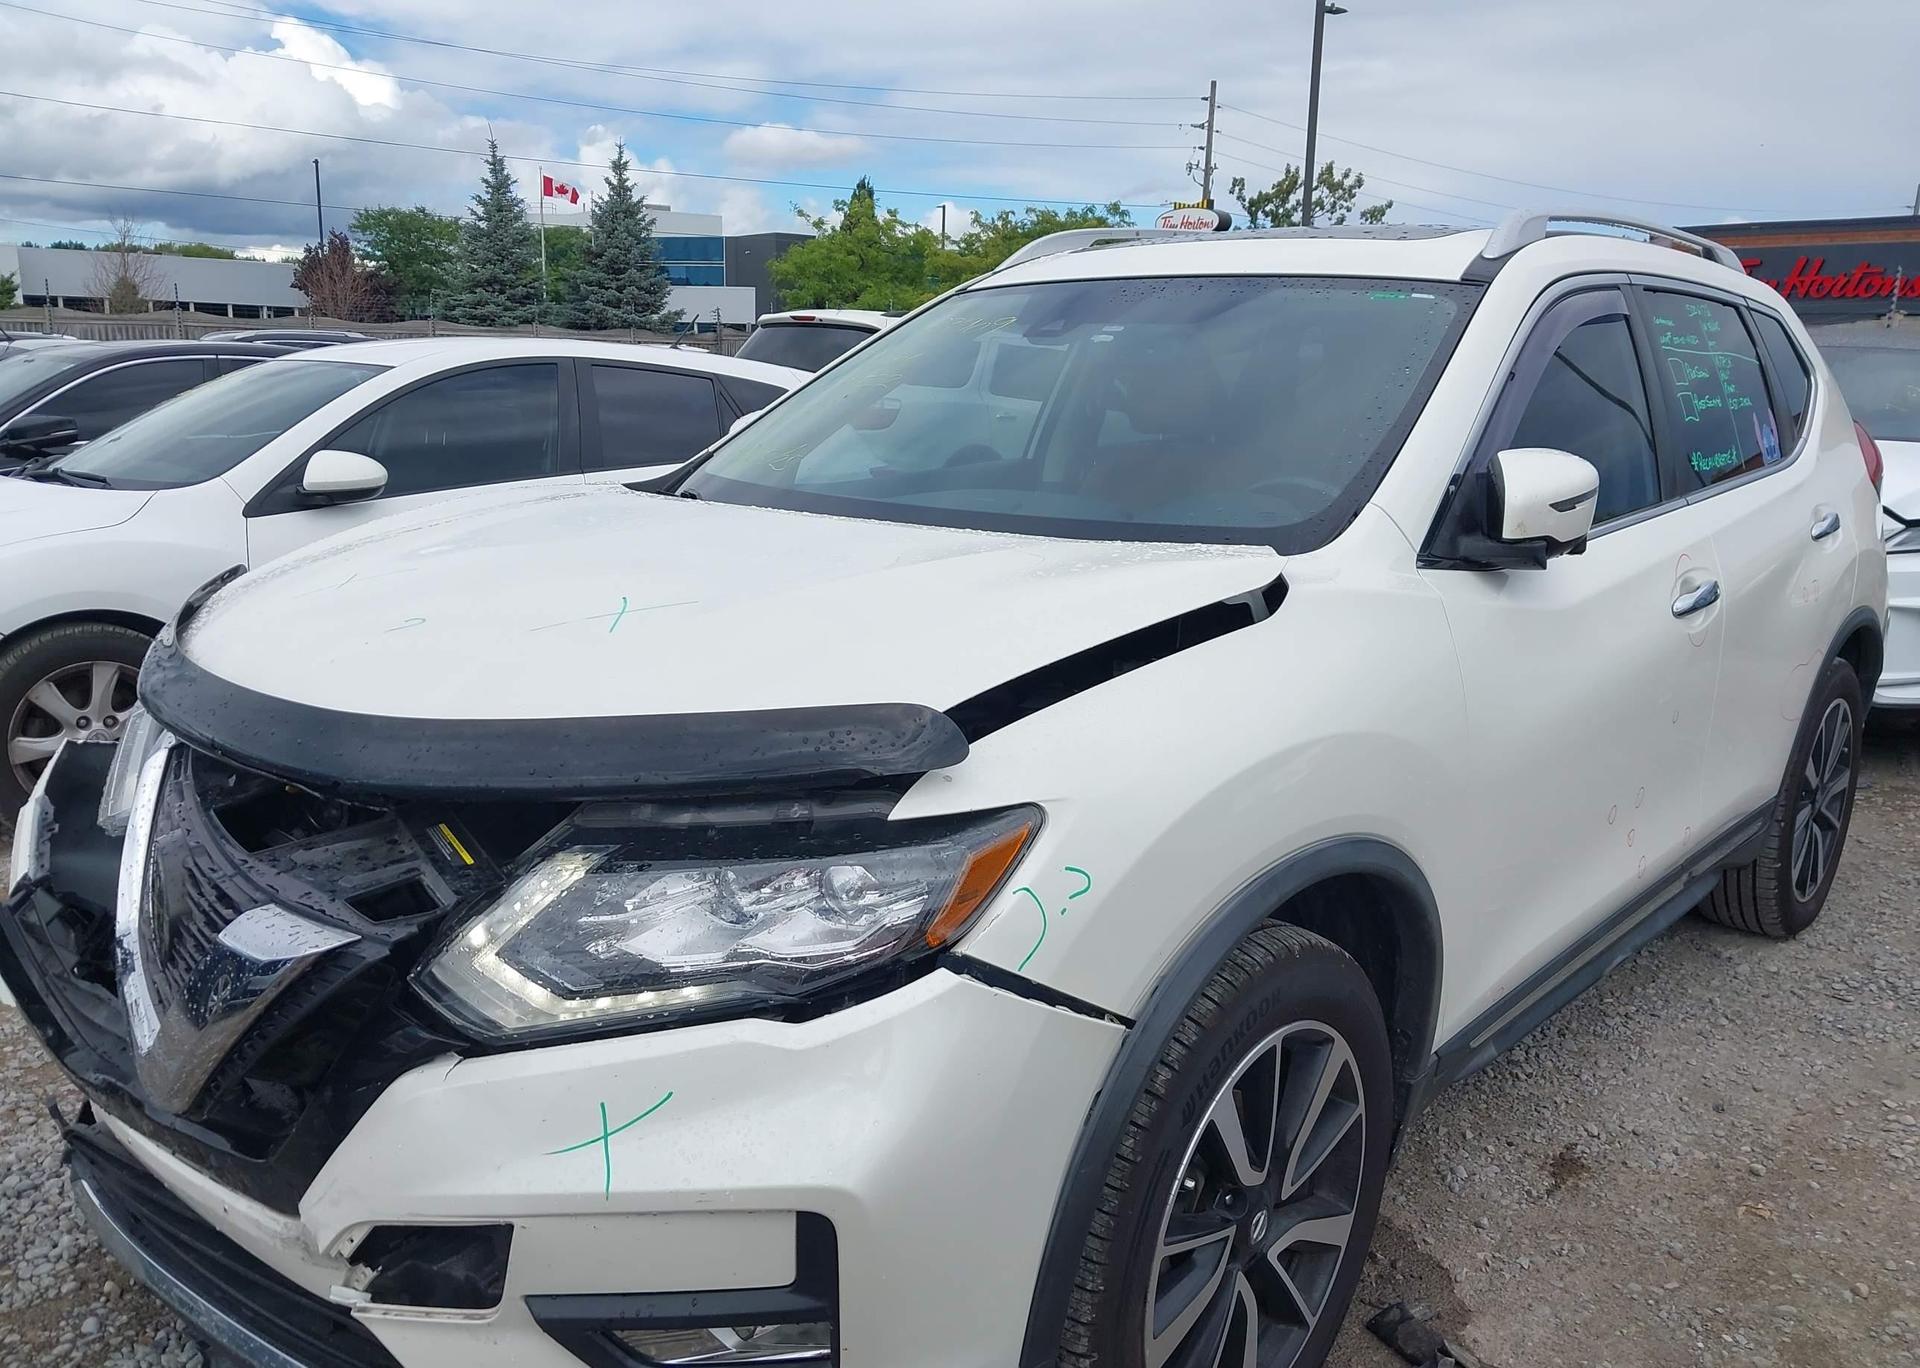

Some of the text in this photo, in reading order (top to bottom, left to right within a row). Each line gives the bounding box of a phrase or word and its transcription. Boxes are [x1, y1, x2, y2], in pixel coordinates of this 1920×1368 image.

[1161, 214, 1214, 230] Tim Hortons
[1781, 255, 1920, 299] Hortons
